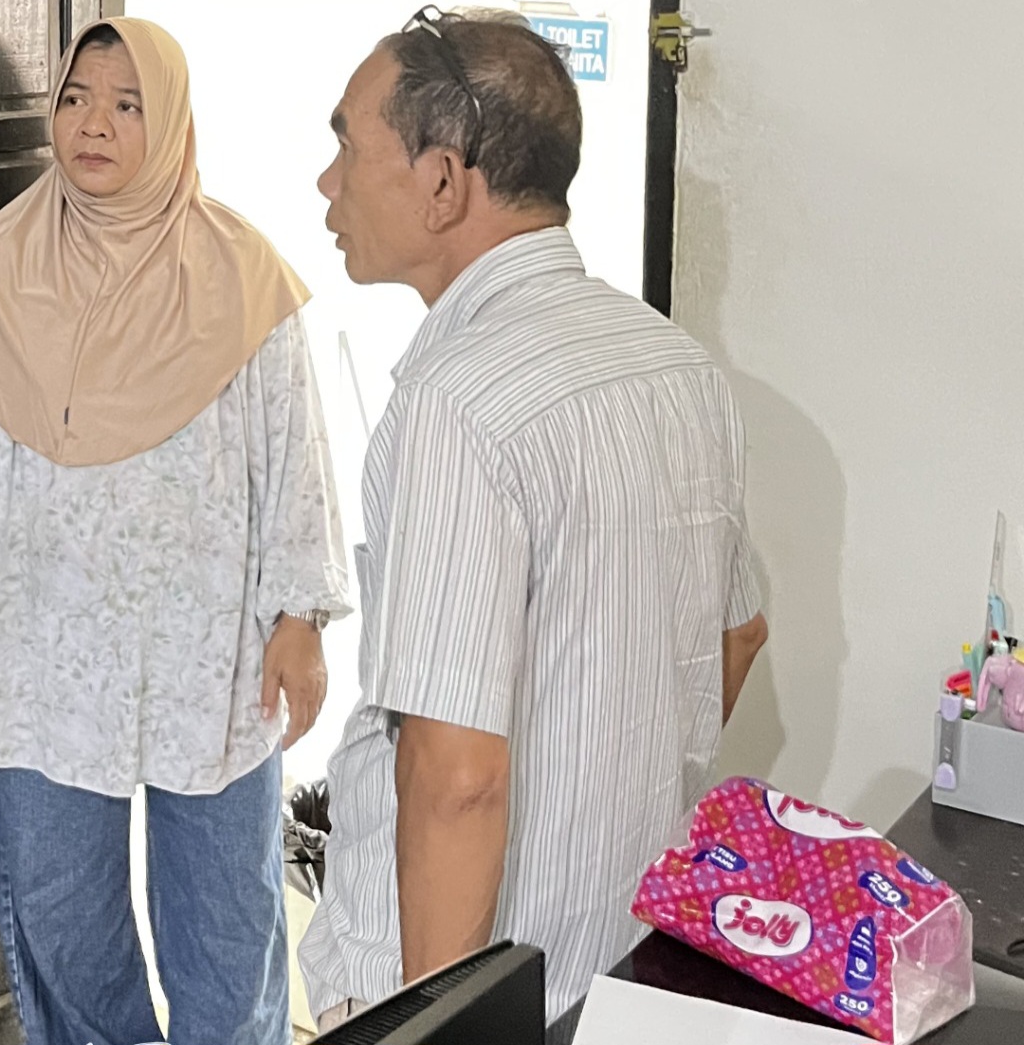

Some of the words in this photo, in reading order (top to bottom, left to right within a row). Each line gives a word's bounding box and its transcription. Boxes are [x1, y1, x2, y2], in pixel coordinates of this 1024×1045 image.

[547, 25, 604, 49] TOILET
[867, 872, 902, 903] 250
[839, 994, 868, 1012] 250
